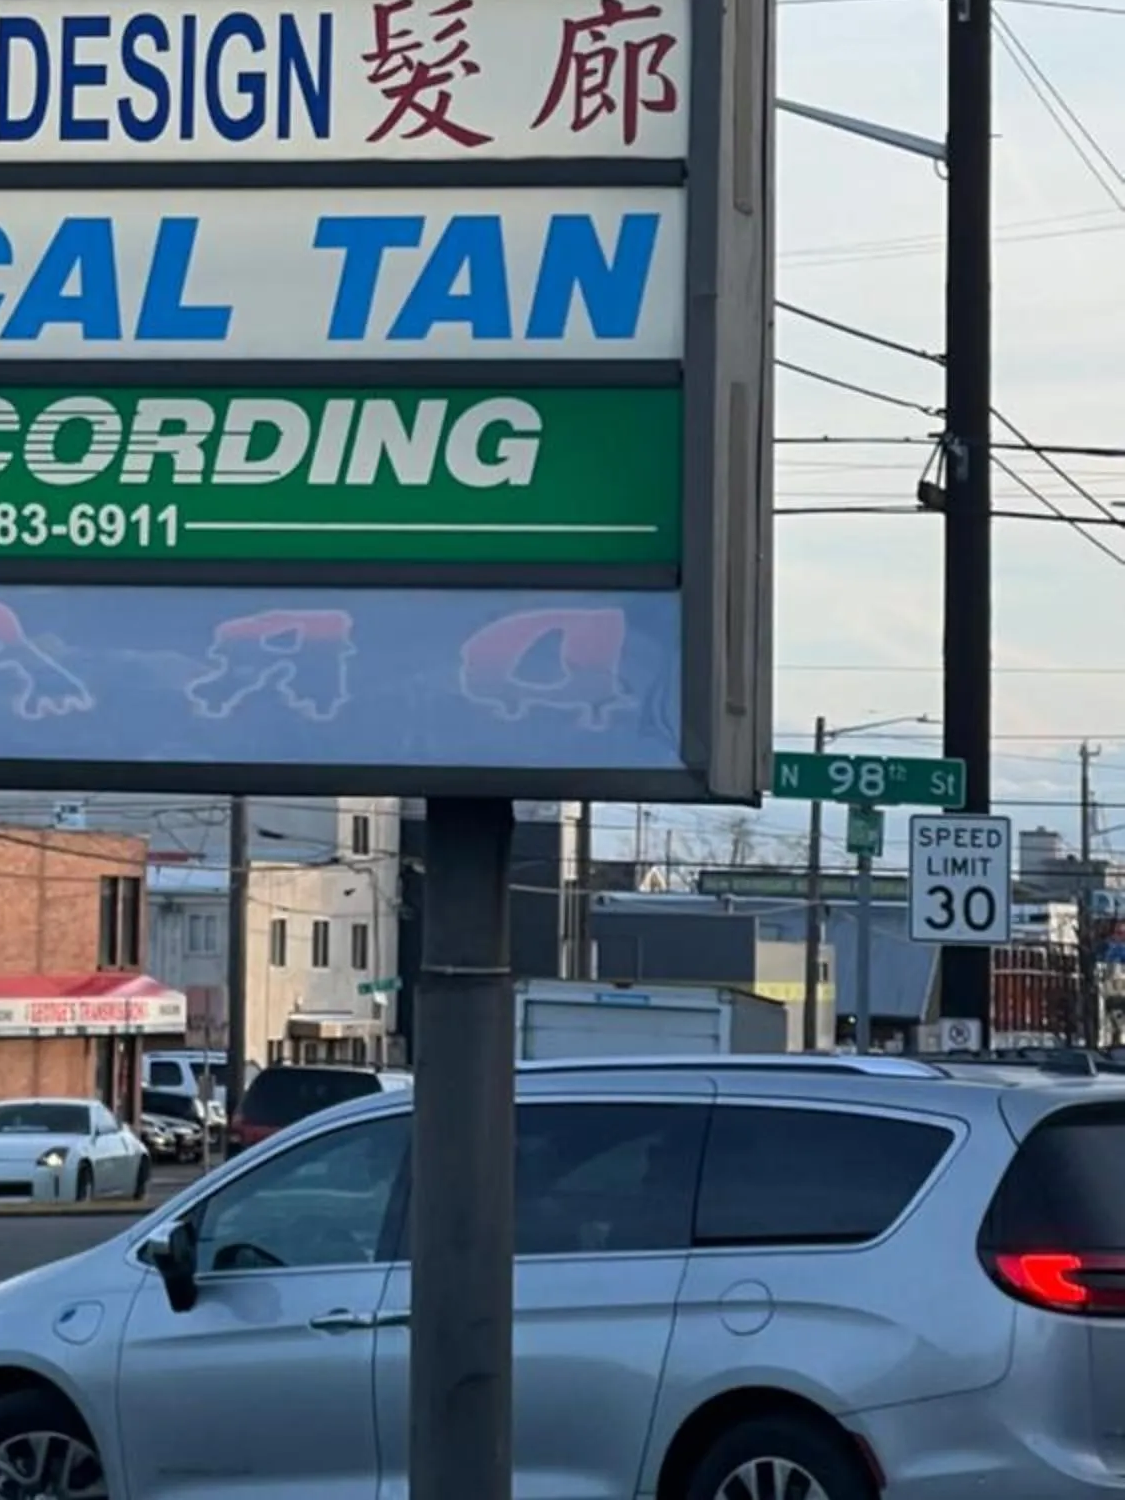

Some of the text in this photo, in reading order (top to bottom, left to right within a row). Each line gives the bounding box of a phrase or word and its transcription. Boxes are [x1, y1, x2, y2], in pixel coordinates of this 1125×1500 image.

[311, 213, 662, 342] TAN
[780, 763, 800, 789] N
[929, 770, 956, 796] St
[918, 826, 1003, 849] SPEED
[926, 855, 992, 877] LIMIT
[924, 885, 996, 932] 30
